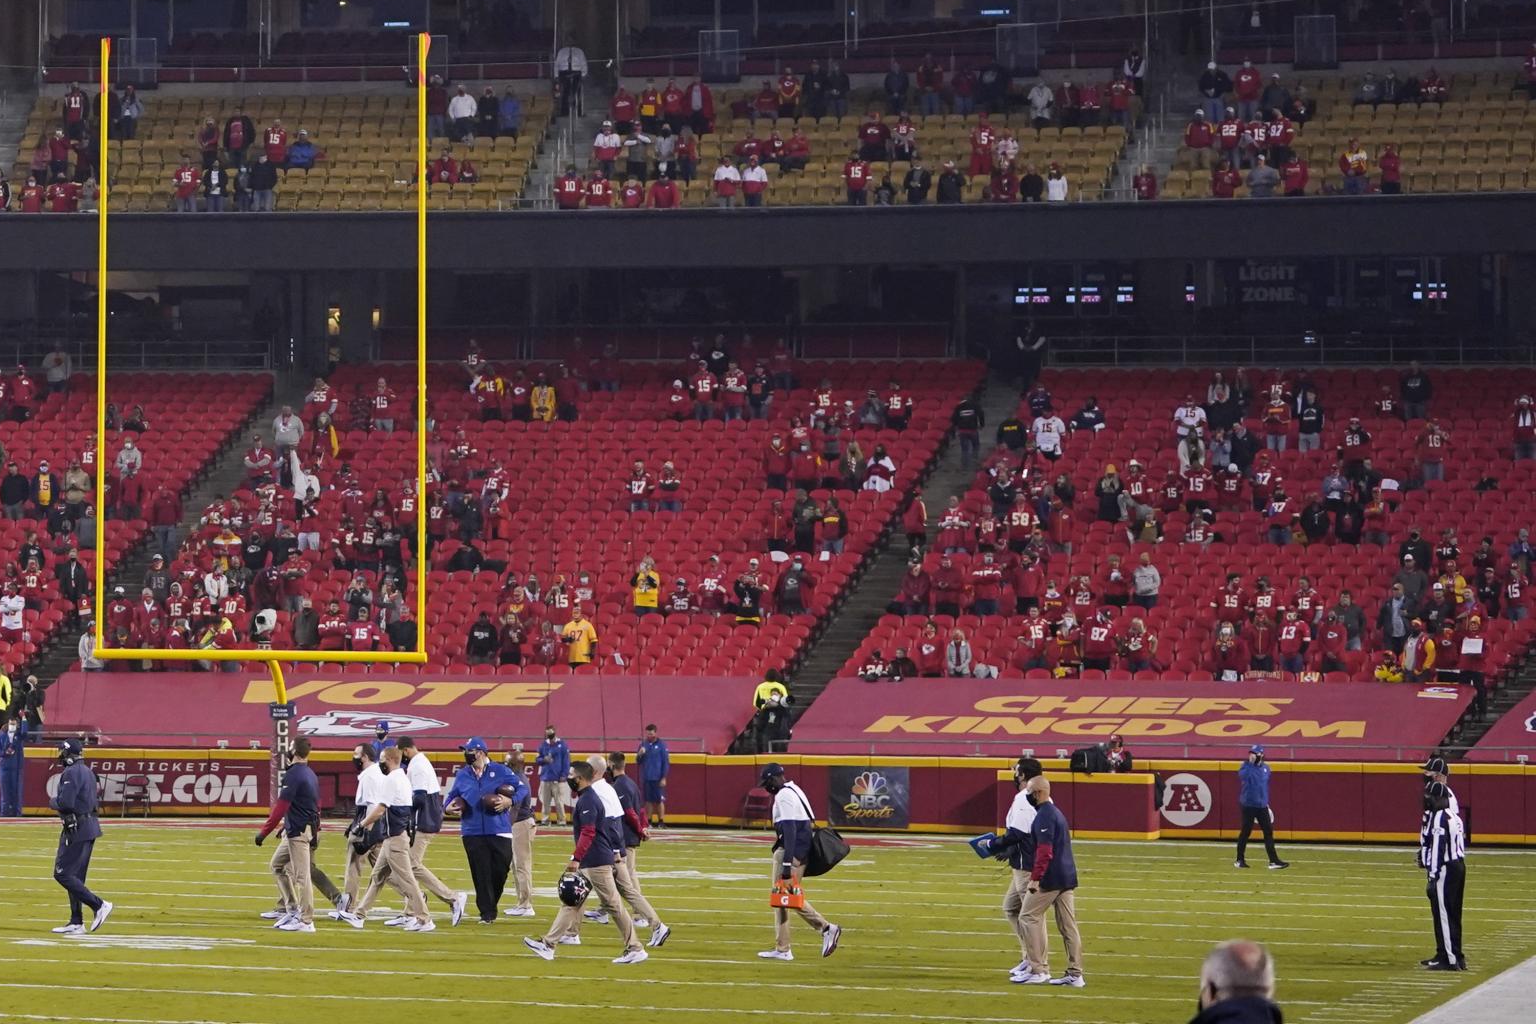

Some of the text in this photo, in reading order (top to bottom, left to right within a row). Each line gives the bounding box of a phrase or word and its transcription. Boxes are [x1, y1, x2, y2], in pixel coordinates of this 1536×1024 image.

[1222, 125, 1237, 136] 22
[269, 133, 280, 144] 15
[565, 181, 575, 191] 10
[698, 380, 710, 391] 15
[1346, 435, 1360, 446] 58
[632, 482, 643, 494] 87
[1012, 512, 1029, 525] 58
[704, 578, 718, 590] 95
[225, 601, 236, 613] 10
[1257, 596, 1271, 607] 58
[171, 604, 181, 615] 15
[355, 628, 367, 639] 15
[1030, 626, 1043, 638] 15
[1091, 628, 1108, 641] 87
[1282, 626, 1295, 639] 13
[241, 680, 565, 706] VOTE
[974, 695, 1295, 716] CHIEFS
[864, 715, 1366, 738] KINGDOM
[90, 761, 220, 772] FOR TICKETS
[850, 794, 890, 808] NBC
[843, 803, 894, 819] Sports
